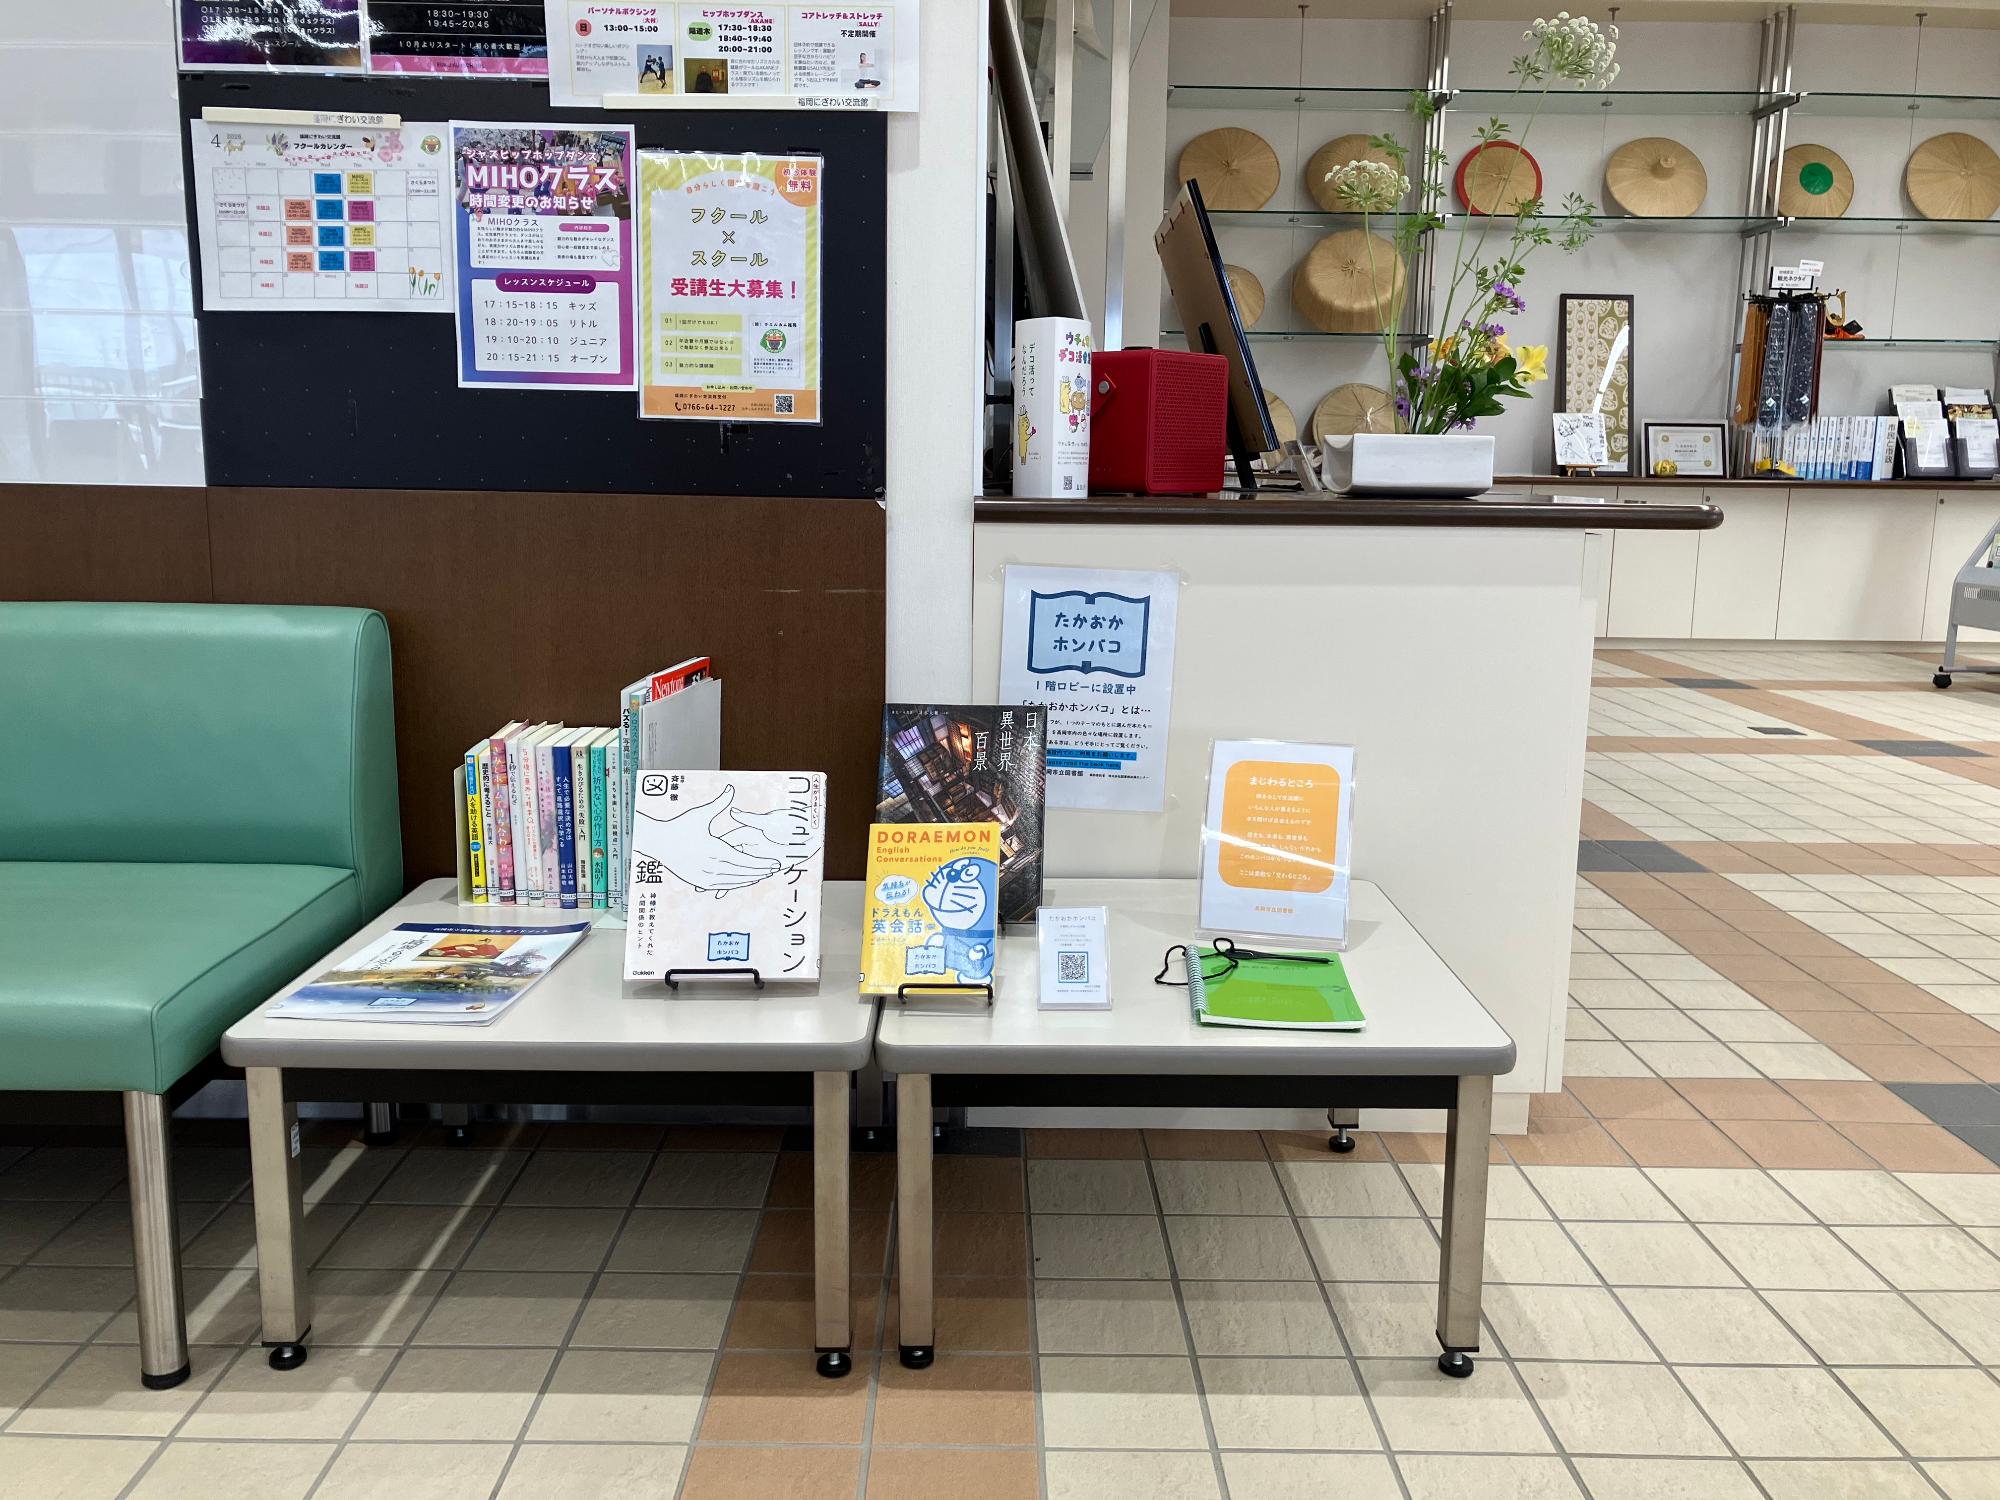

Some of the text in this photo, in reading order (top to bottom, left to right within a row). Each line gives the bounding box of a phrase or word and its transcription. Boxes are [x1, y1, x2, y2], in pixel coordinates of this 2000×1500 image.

[427, 10, 489, 19] 18:30~19:30
[587, 6, 657, 16] パーソナルボクシング
[702, 10, 764, 18] ヒップホップダンス
[580, 22, 658, 33] 日 13:00~15:00
[718, 24, 772, 32] 17:30~18:30
[840, 29, 876, 38] 不定期開催
[718, 35, 772, 43] 18:40~19:40
[718, 46, 772, 54] 20:00~21:00
[210, 133, 221, 148] 4
[467, 165, 617, 190] MIHOクラス
[469, 194, 594, 210] 時間変更のお知らせ
[691, 207, 768, 224] フクール
[488, 218, 539, 227] MIHOクラス
[691, 250, 768, 267] スクール
[504, 278, 590, 288] レッスンスケジュール
[670, 278, 797, 299] 受講生大募集！
[568, 302, 597, 311] キッズ
[570, 319, 598, 328] リトル
[570, 336, 608, 346] ジュニア
[570, 354, 608, 364] オープン
[1054, 612, 1124, 630] たかおか
[1052, 636, 1121, 654] ホンバコ
[1024, 712, 1039, 749] 日本
[996, 710, 1015, 772] 異世界
[973, 730, 989, 770] 百景
[1249, 776, 1315, 788] まじわるところ
[877, 830, 991, 844] DORAEMON
[876, 846, 910, 856] English
[876, 855, 943, 863] Conversations
[635, 860, 664, 884] 鑑
[782, 776, 811, 973] コミュニケーション
[872, 908, 923, 918] ドラえもん
[638, 892, 646, 950] 人間関係のヒント
[646, 892, 657, 956] 神様が教えてくれた
[872, 918, 923, 934] 英会話
